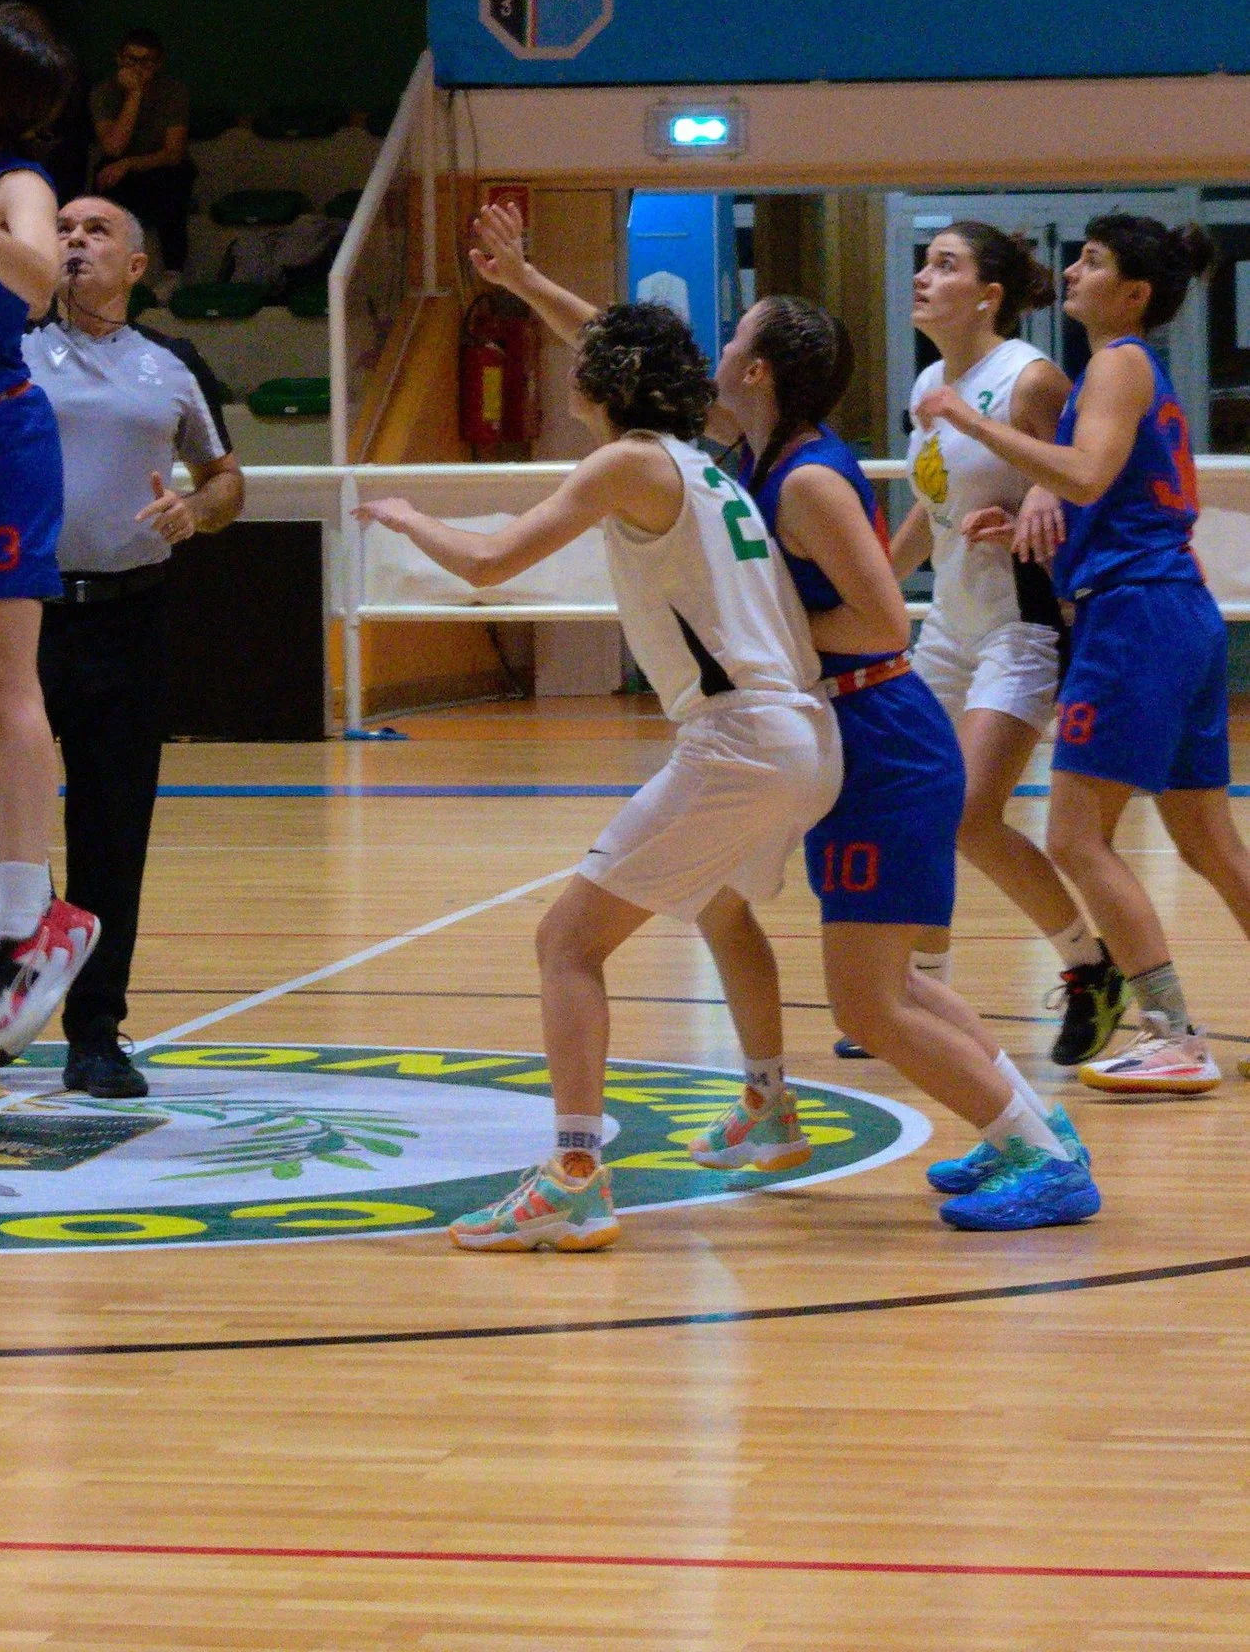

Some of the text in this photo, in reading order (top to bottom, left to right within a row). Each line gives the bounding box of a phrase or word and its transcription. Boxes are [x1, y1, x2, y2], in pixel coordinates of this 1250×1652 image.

[1153, 402, 1200, 512] 3
[1057, 702, 1097, 745] 8
[822, 841, 880, 893] 10
